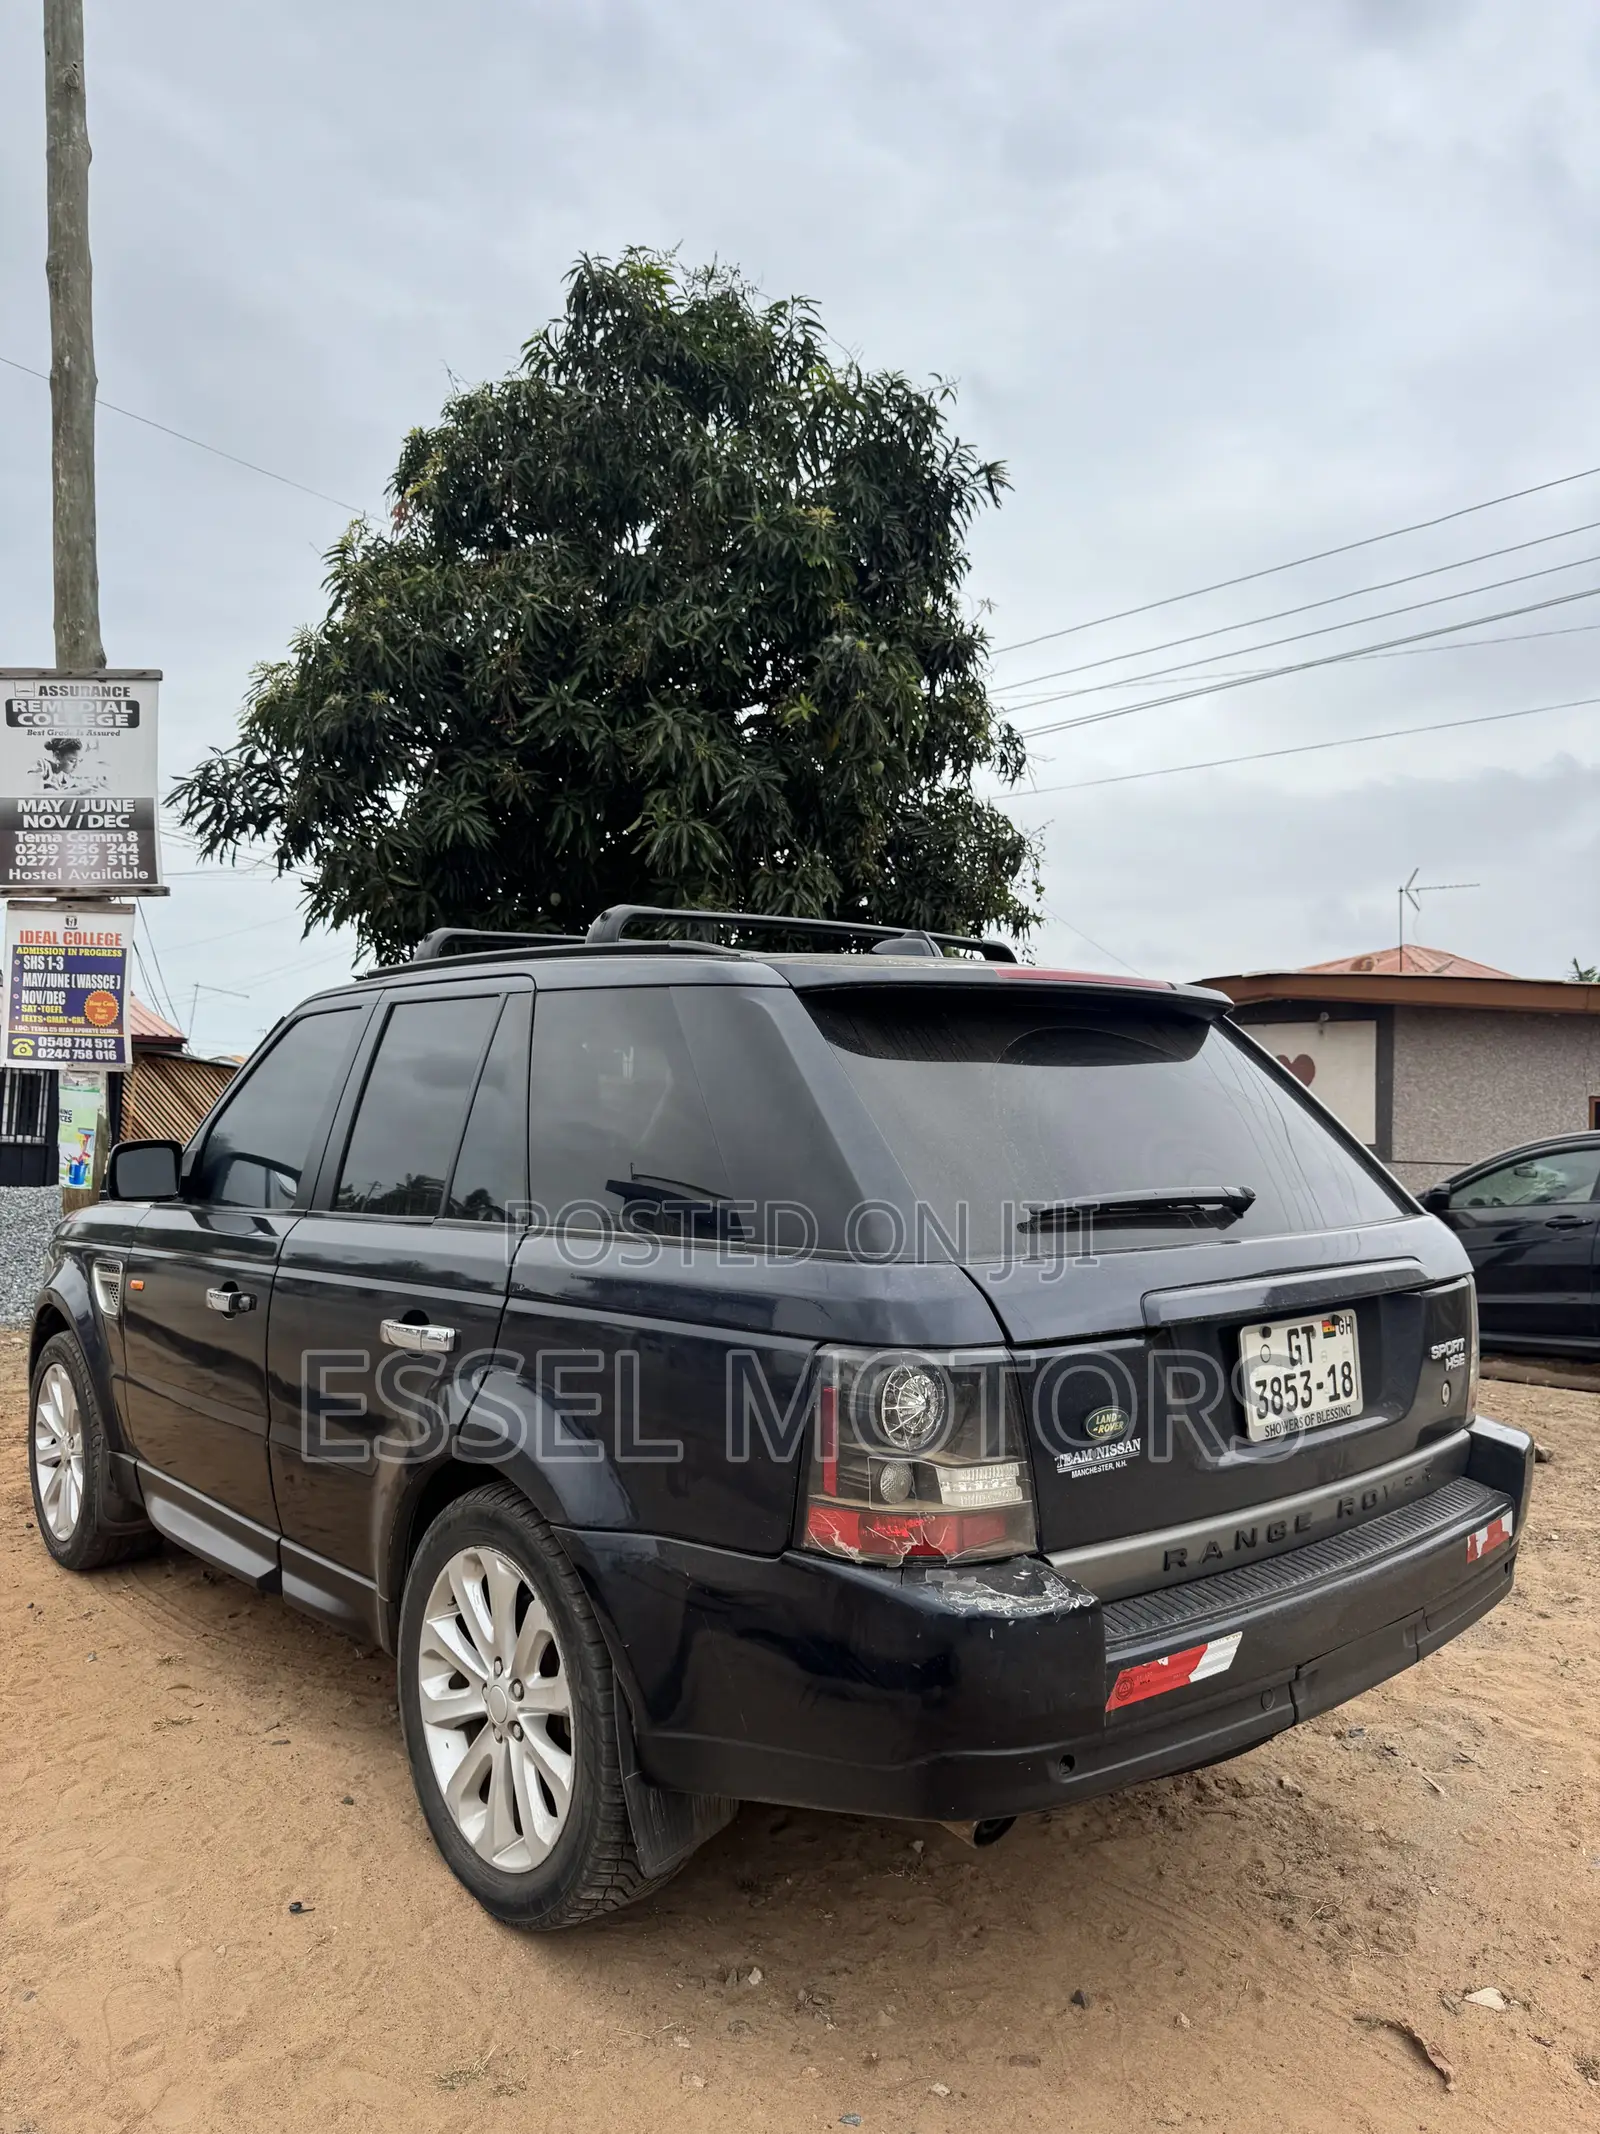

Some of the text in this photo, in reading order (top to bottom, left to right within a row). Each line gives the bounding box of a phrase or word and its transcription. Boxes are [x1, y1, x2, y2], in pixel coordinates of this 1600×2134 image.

[38, 685, 131, 698] ASSURANCE
[12, 700, 133, 714] REMEDIAL
[17, 713, 130, 727] COLLEGE
[27, 729, 45, 737] Best
[47, 729, 72, 737] Grad
[86, 729, 121, 737] Assured
[17, 800, 64, 813] MAY
[80, 799, 136, 813] JUNE
[23, 815, 71, 829] NOV
[88, 814, 130, 828] DEC
[15, 831, 139, 843] Tema Comm 8
[15, 843, 139, 855] 0249 256 244
[15, 854, 139, 866] 0277 247 515
[8, 867, 149, 880] Hostel Available
[20, 930, 122, 947] IDEAL COLLEGE
[16, 947, 122, 957] ADMISSION IN PROGRESS
[23, 955, 64, 971] SHS 1-3
[22, 972, 70, 988] MAY/JUNE
[21, 990, 66, 1005] NOV/DEC
[38, 1036, 115, 1049] 0548 714 512
[37, 1047, 117, 1060] 0244 758 016
[1338, 1315, 1353, 1336] GH
[1286, 1325, 1315, 1367] GT
[1430, 1337, 1465, 1360] SPORT
[1445, 1352, 1465, 1372] HSE
[1255, 1361, 1354, 1420] 3853-18
[1095, 1412, 1118, 1425] LAND
[1264, 1405, 1352, 1438] SHOWERS OF BLESSING
[1097, 1421, 1124, 1434] ROVER
[1054, 1438, 1141, 1468] TEAM NISSAN
[1071, 1460, 1128, 1479] MANCHESTER, N.H.
[1163, 1510, 1313, 1572] RANGE
